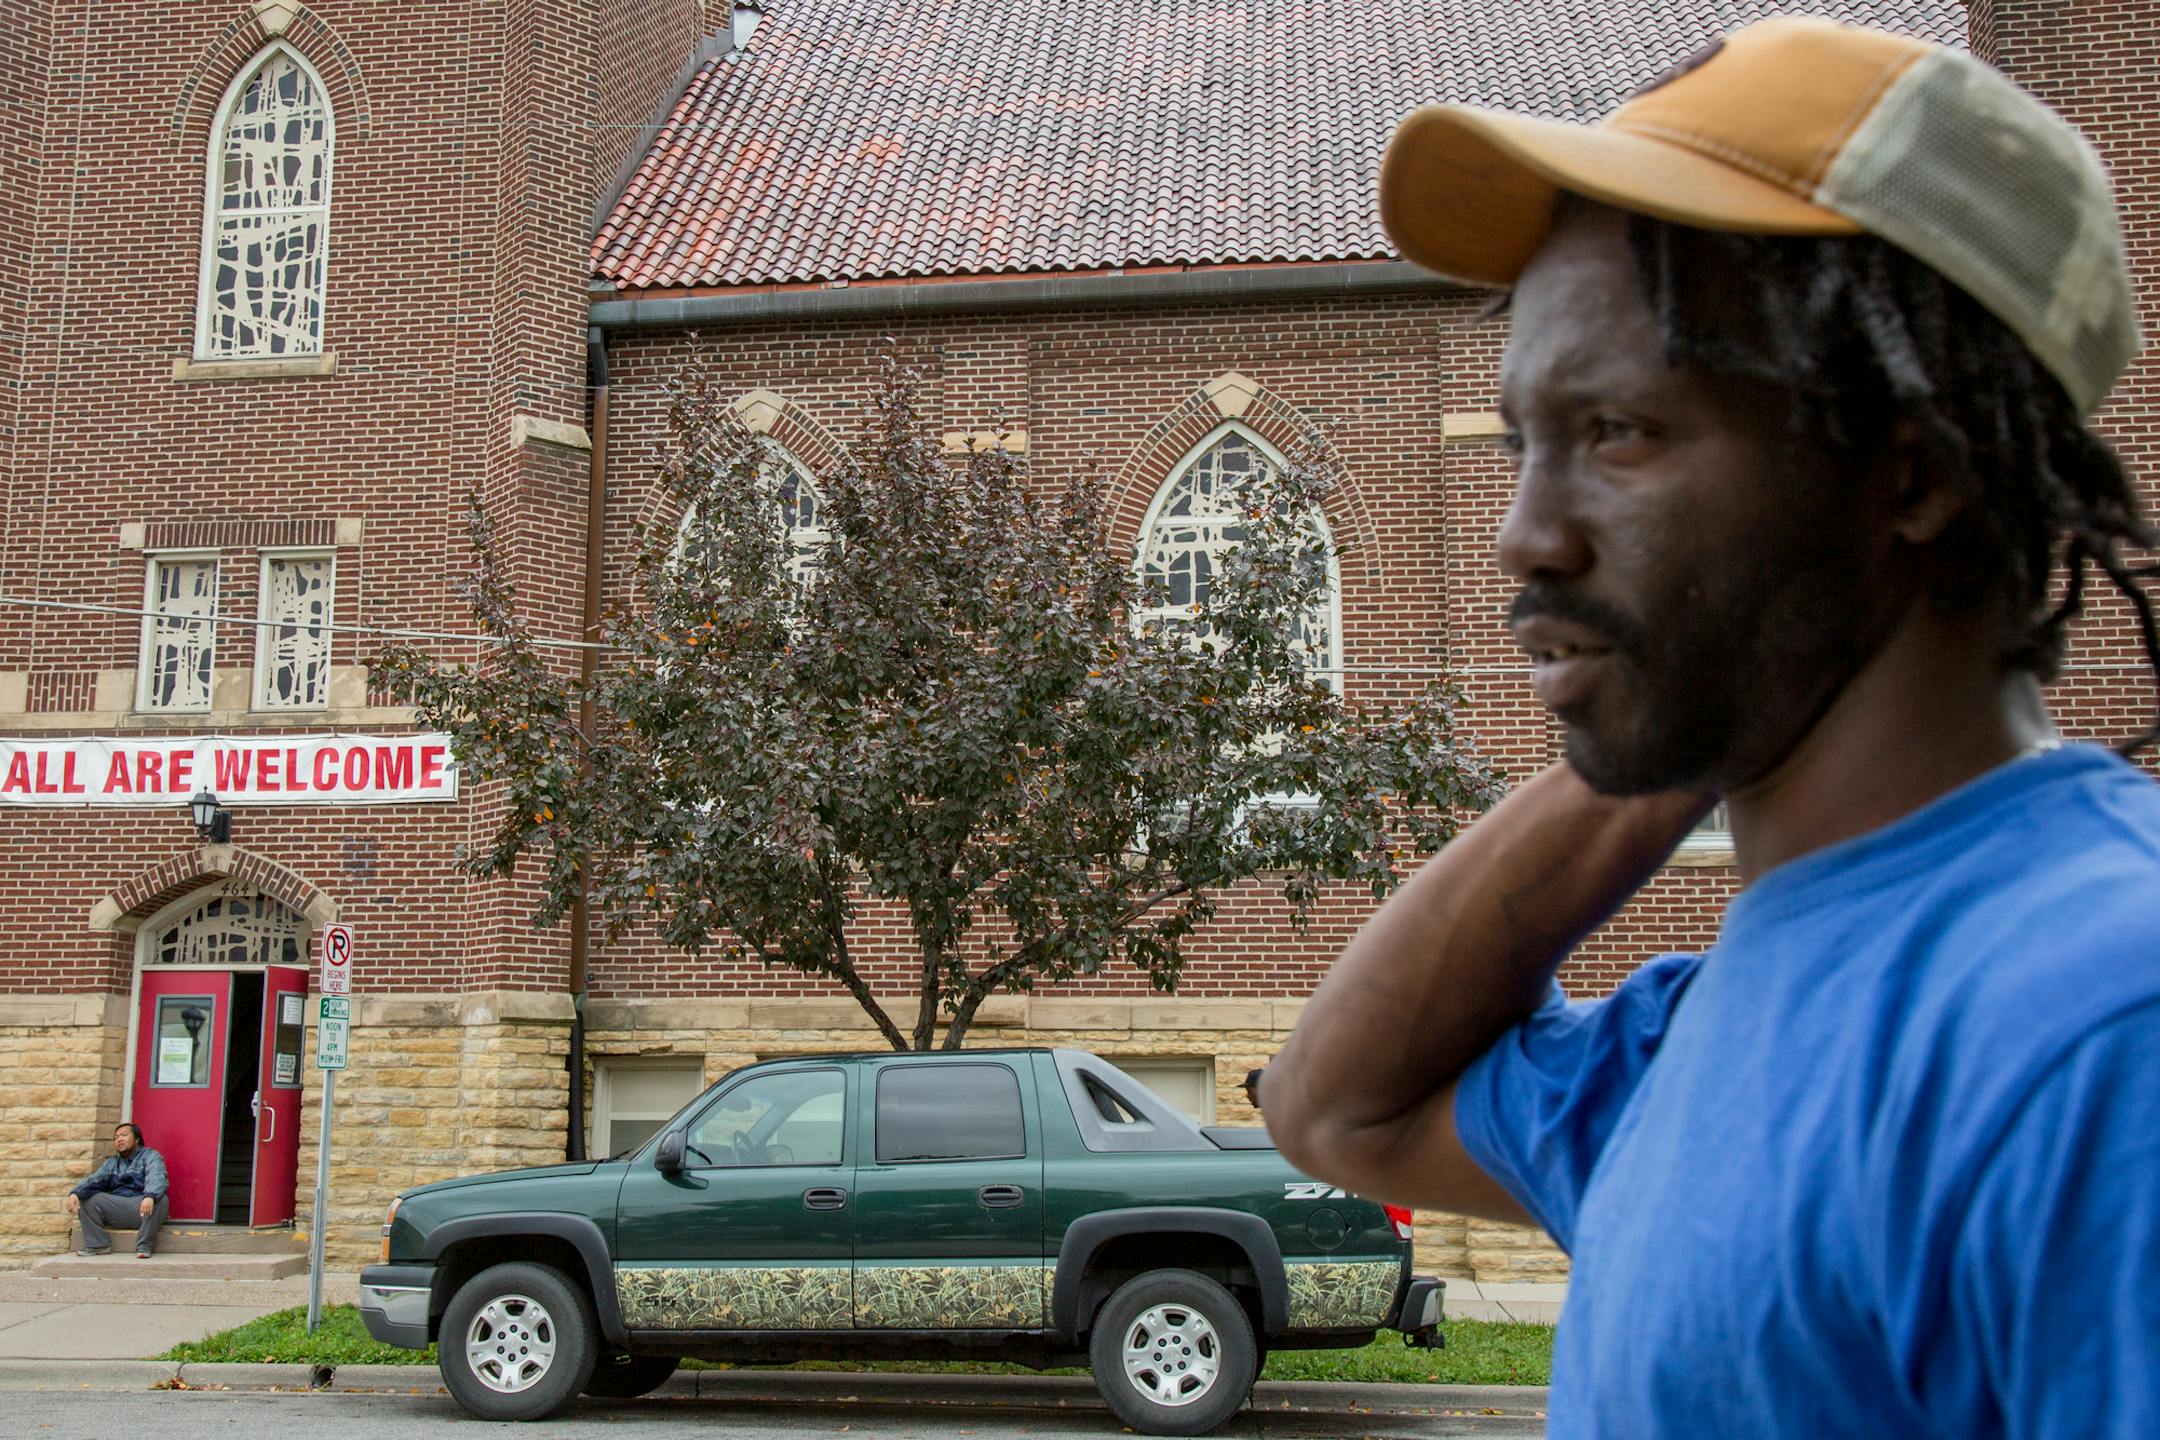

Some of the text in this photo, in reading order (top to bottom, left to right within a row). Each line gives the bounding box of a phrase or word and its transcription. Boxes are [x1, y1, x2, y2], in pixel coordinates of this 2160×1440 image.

[2, 746, 446, 794] ALL ARE WELCOME
[221, 882, 249, 896] 464
[327, 969, 346, 979] BEGINS
[328, 980, 343, 991] HERE
[323, 1000, 329, 1015] 2
[326, 1021, 342, 1031] NOON
[329, 1032, 337, 1041] TO
[326, 1042, 338, 1051] 4PM
